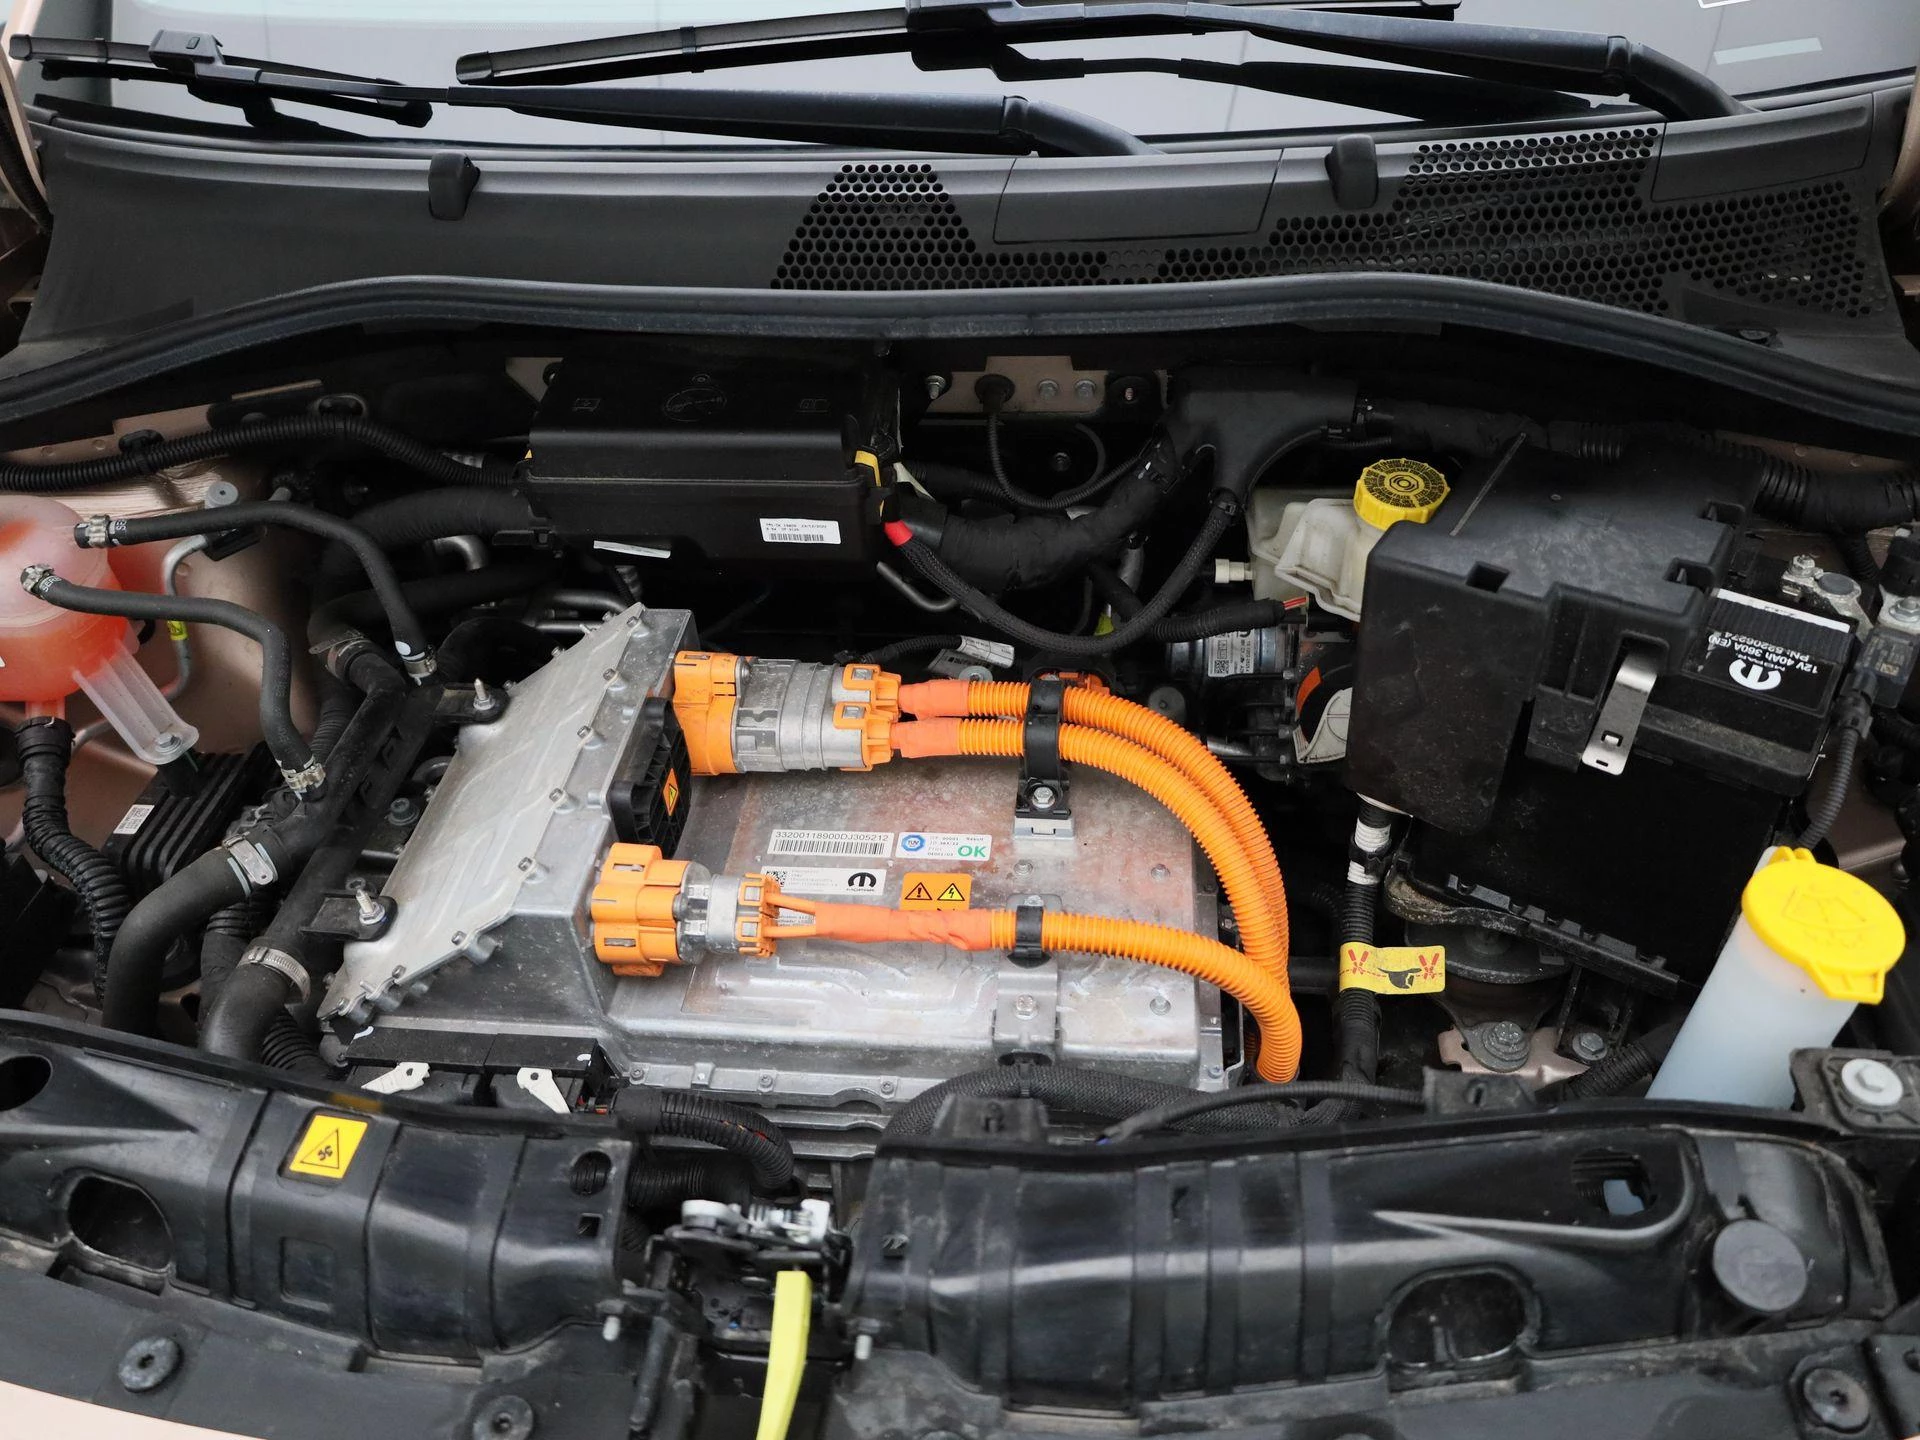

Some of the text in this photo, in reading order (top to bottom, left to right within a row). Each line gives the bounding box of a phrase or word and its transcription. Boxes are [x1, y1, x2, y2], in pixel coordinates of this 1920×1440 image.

[1708, 634, 1819, 674] 12V 40Ah 360A (EN)
[1786, 649, 1810, 662] PN:
[957, 845, 986, 858] OK
